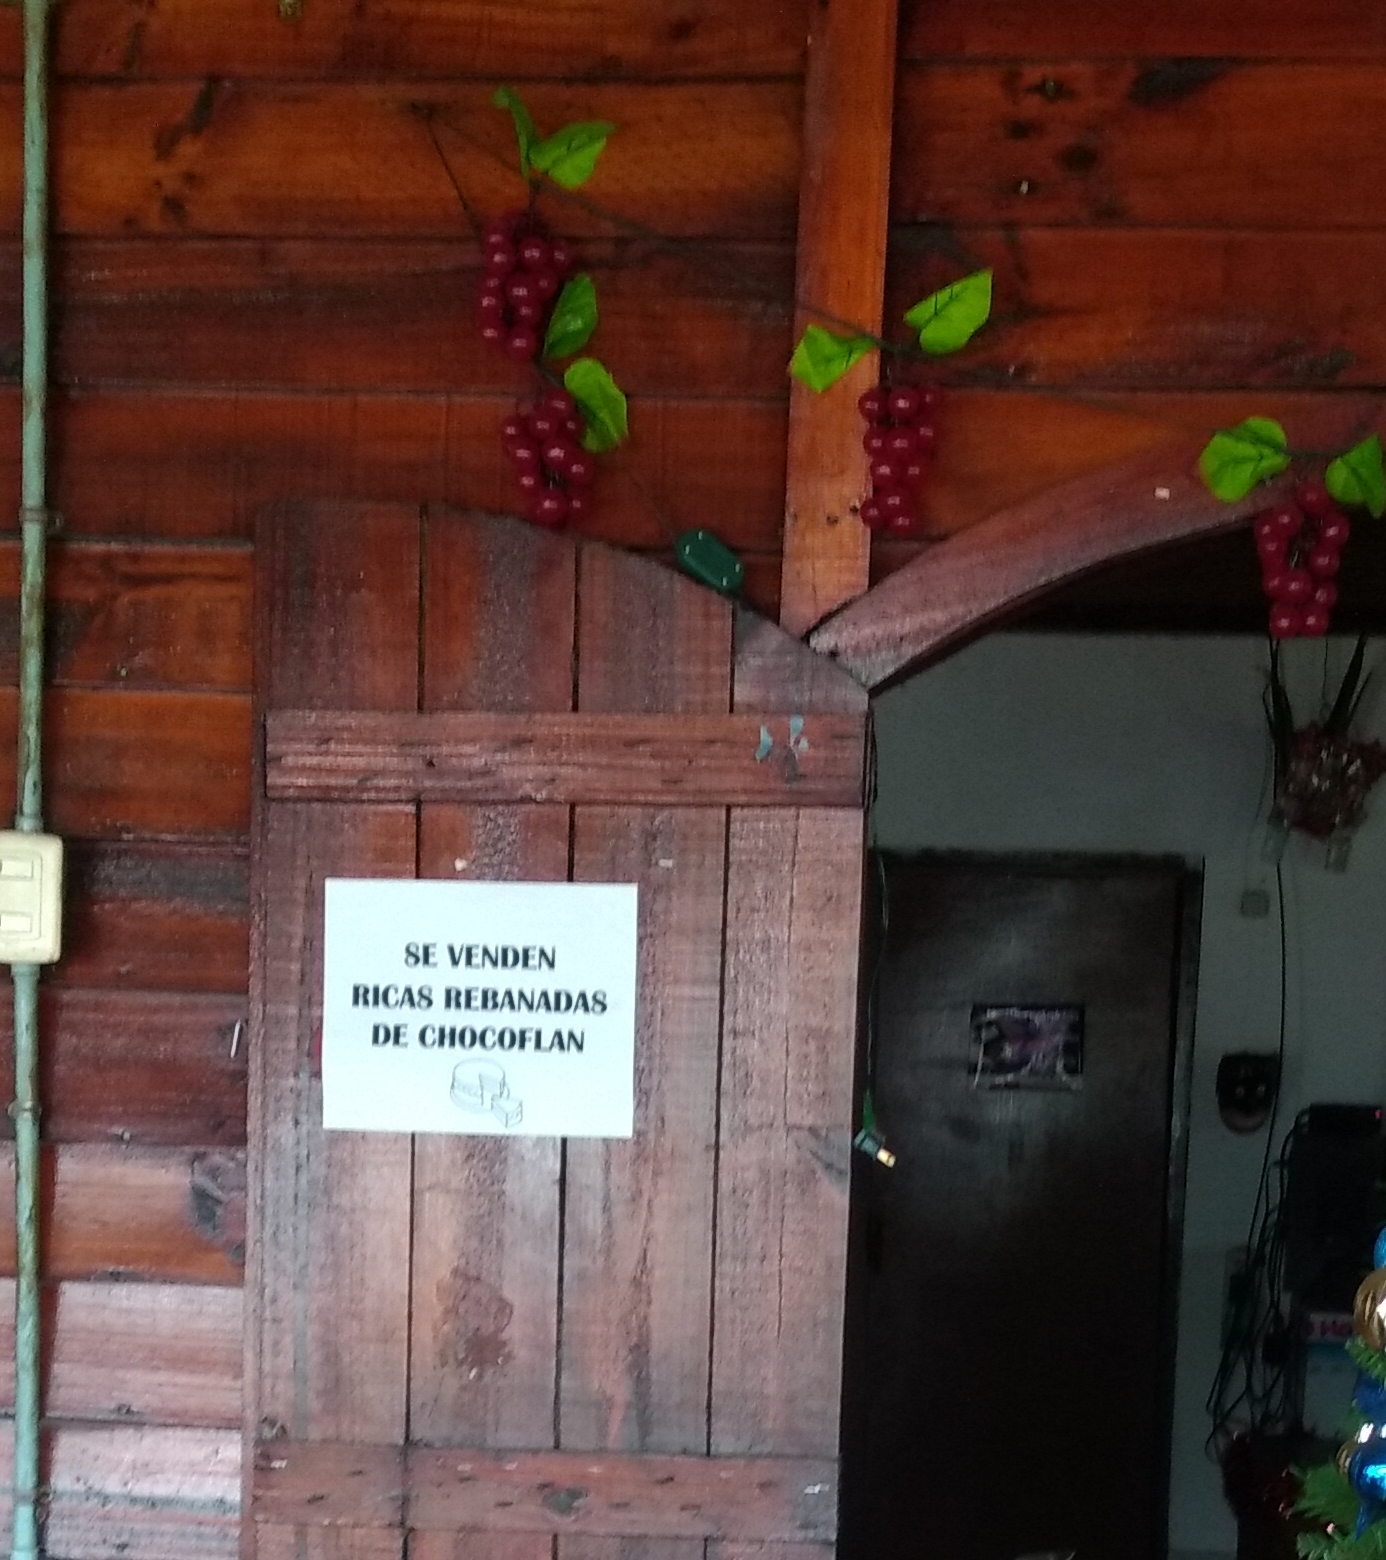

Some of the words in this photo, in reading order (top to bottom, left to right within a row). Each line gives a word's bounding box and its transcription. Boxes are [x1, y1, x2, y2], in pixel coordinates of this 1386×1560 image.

[404, 941, 438, 969] SE
[446, 943, 556, 972] VENDEN
[351, 982, 433, 1011] RICAS
[443, 985, 608, 1015] REBANADAS
[371, 1022, 409, 1049] DE
[417, 1024, 586, 1055] CHOCOFLAN
